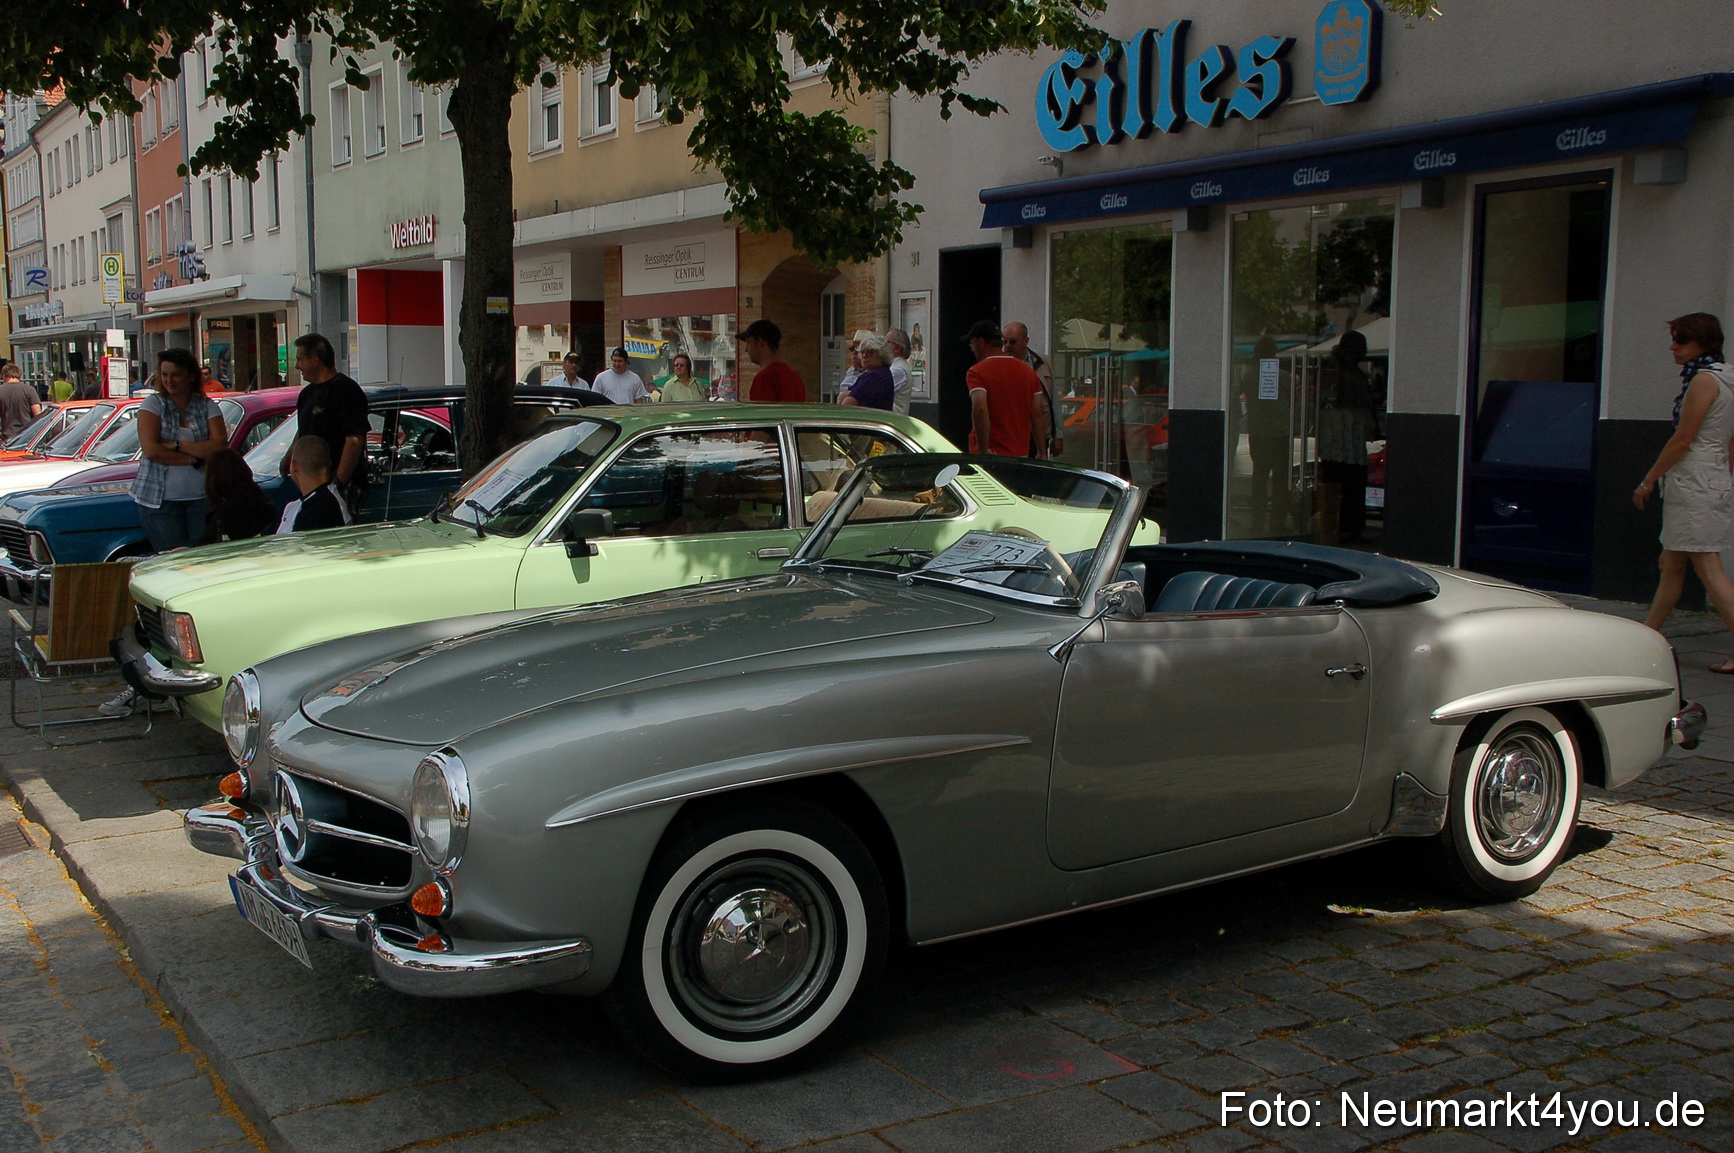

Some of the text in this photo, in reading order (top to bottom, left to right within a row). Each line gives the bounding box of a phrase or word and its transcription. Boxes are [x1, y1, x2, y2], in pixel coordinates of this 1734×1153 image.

[1035, 19, 1291, 152] Eilles
[1556, 127, 1607, 150] Eilles
[1413, 150, 1457, 171] Eilles
[1293, 167, 1330, 186] Eilles
[1190, 180, 1222, 199] Eilles
[1100, 193, 1128, 209] Eilles
[1021, 203, 1046, 219] Eilles
[389, 213, 435, 249] Weltbild
[644, 249, 692, 266] Reissinger Optik
[911, 251, 920, 267] 31
[519, 266, 542, 281] Reissinger
[675, 266, 705, 280] CENTRUM
[541, 281, 564, 292] CENTRUM
[981, 544, 1025, 562] 273
